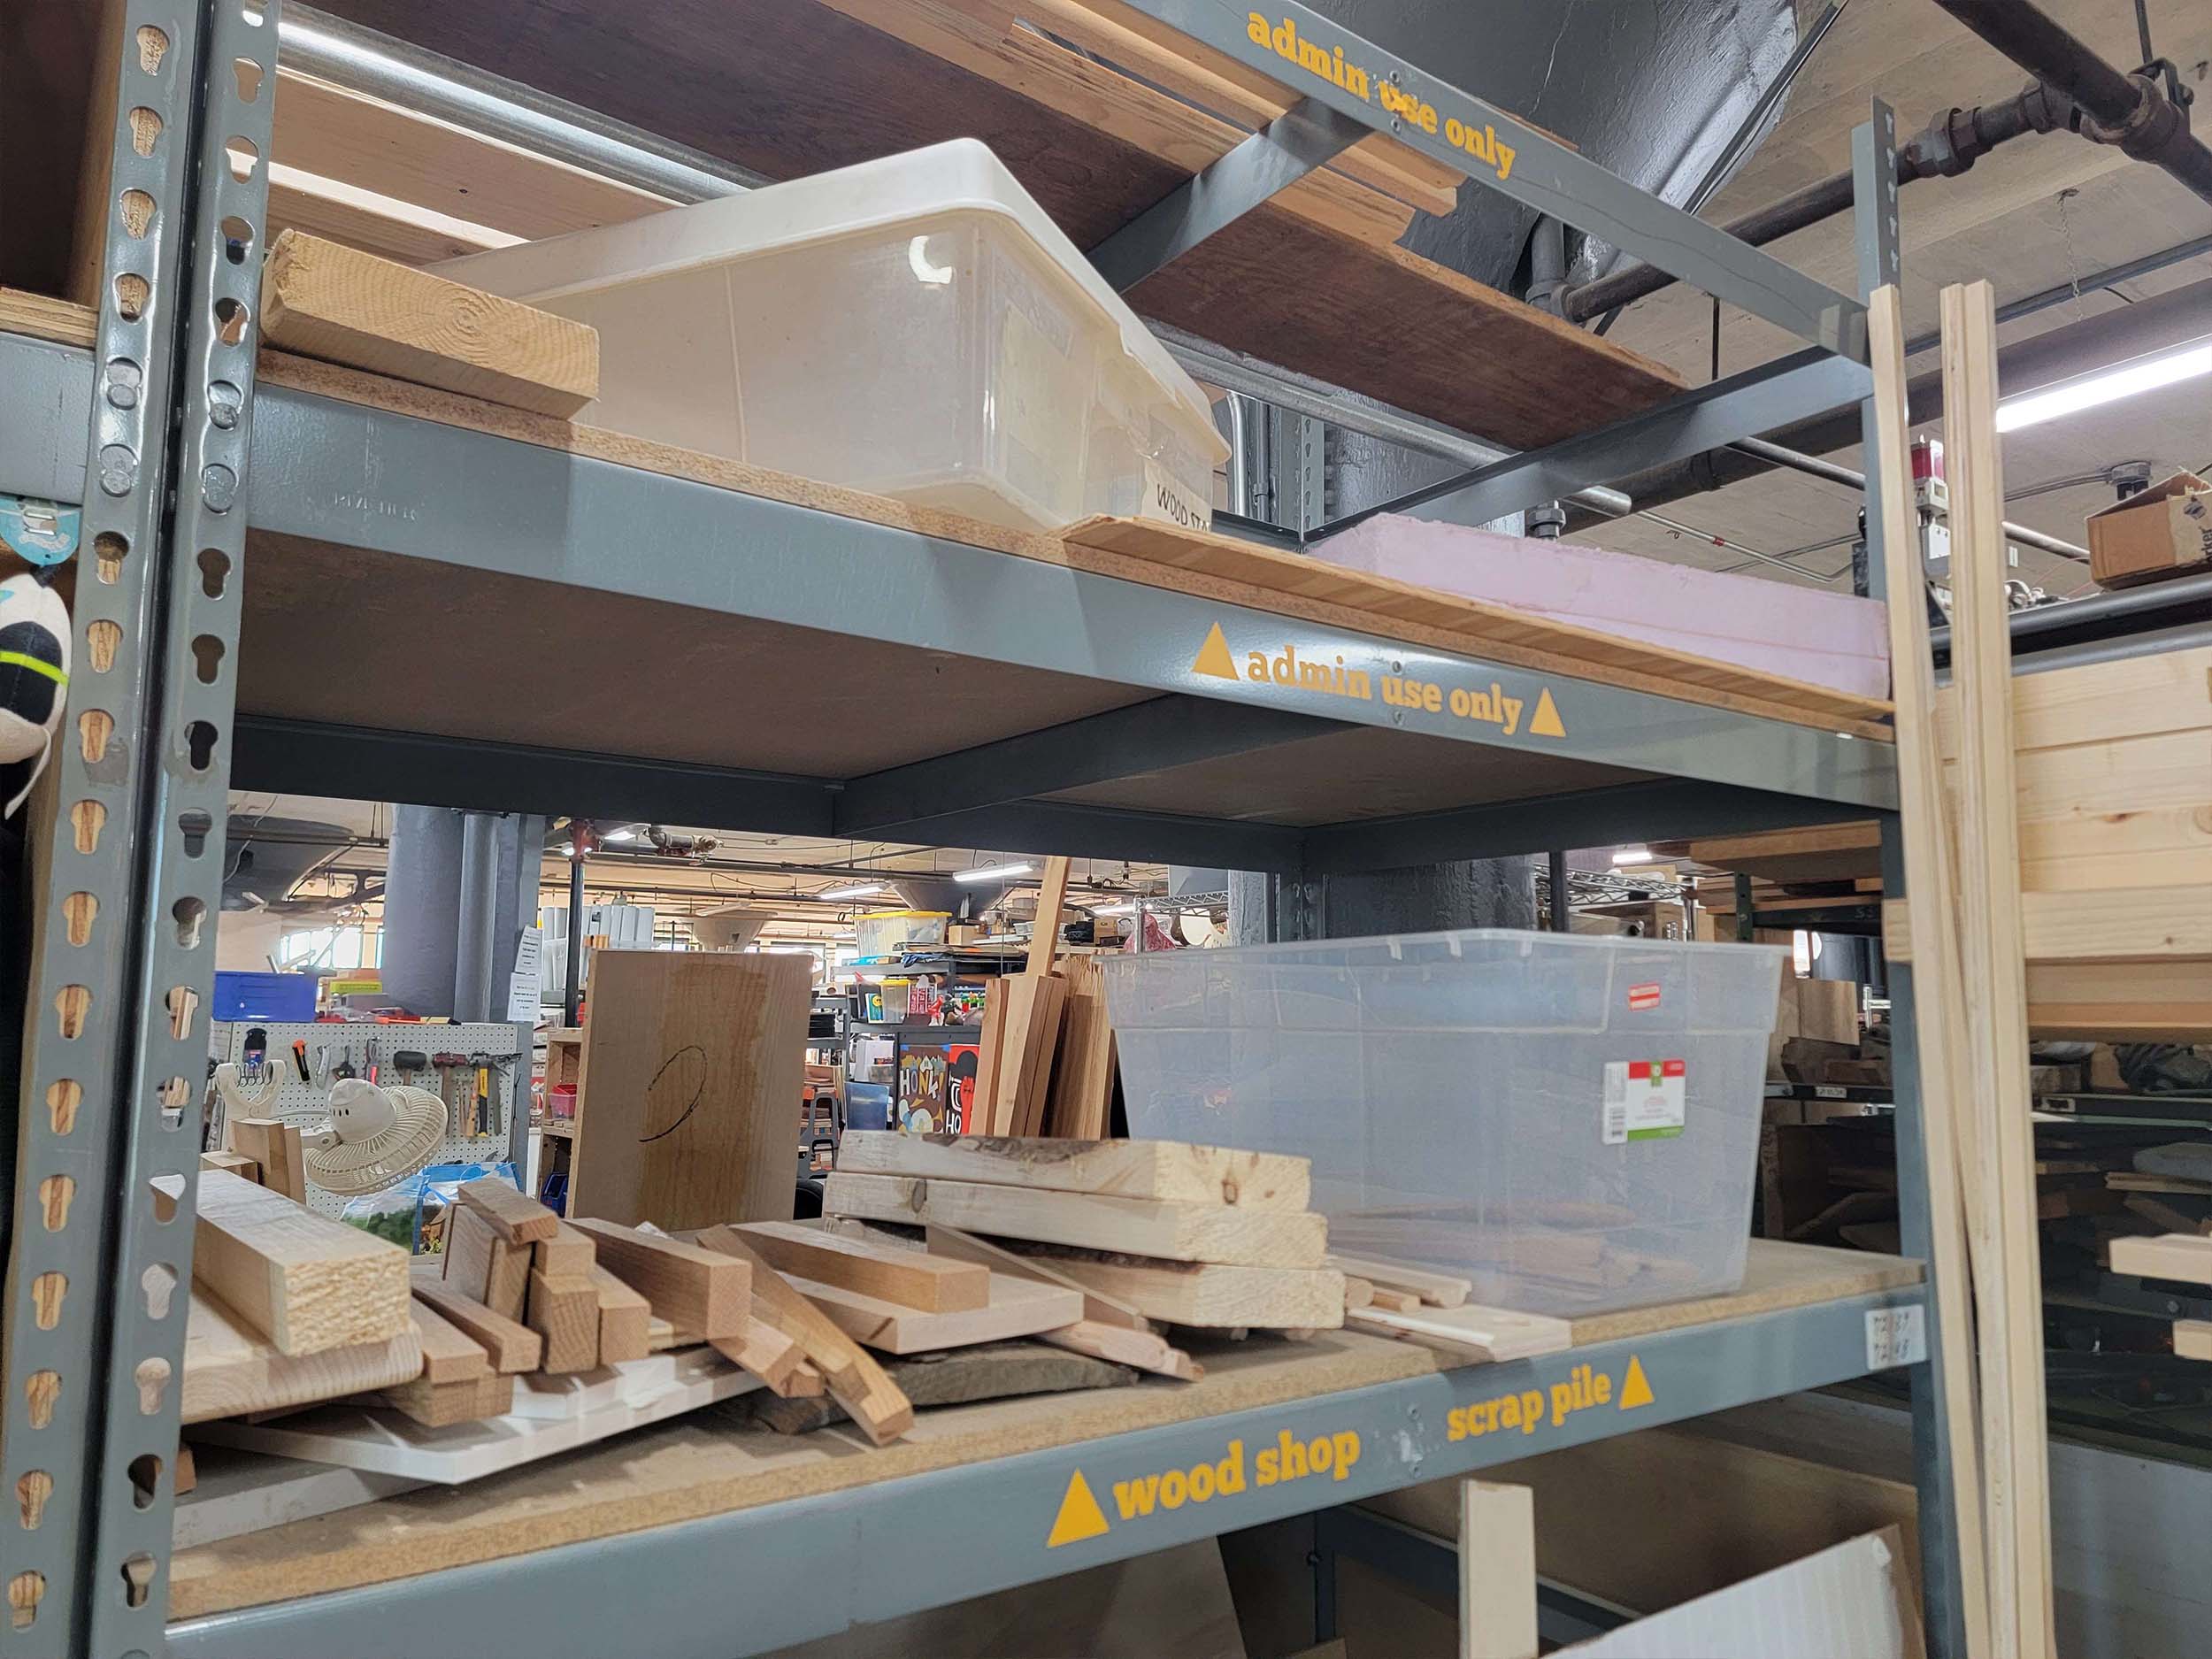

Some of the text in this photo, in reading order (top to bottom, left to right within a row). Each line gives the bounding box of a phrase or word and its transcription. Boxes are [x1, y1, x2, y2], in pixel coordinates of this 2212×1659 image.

[1246, 12, 1516, 180] admin use only
[1156, 483, 1188, 526] WOOD
[1248, 645, 1524, 736] admin use only
[1112, 1363, 1612, 1520] wood shop scrap pile
